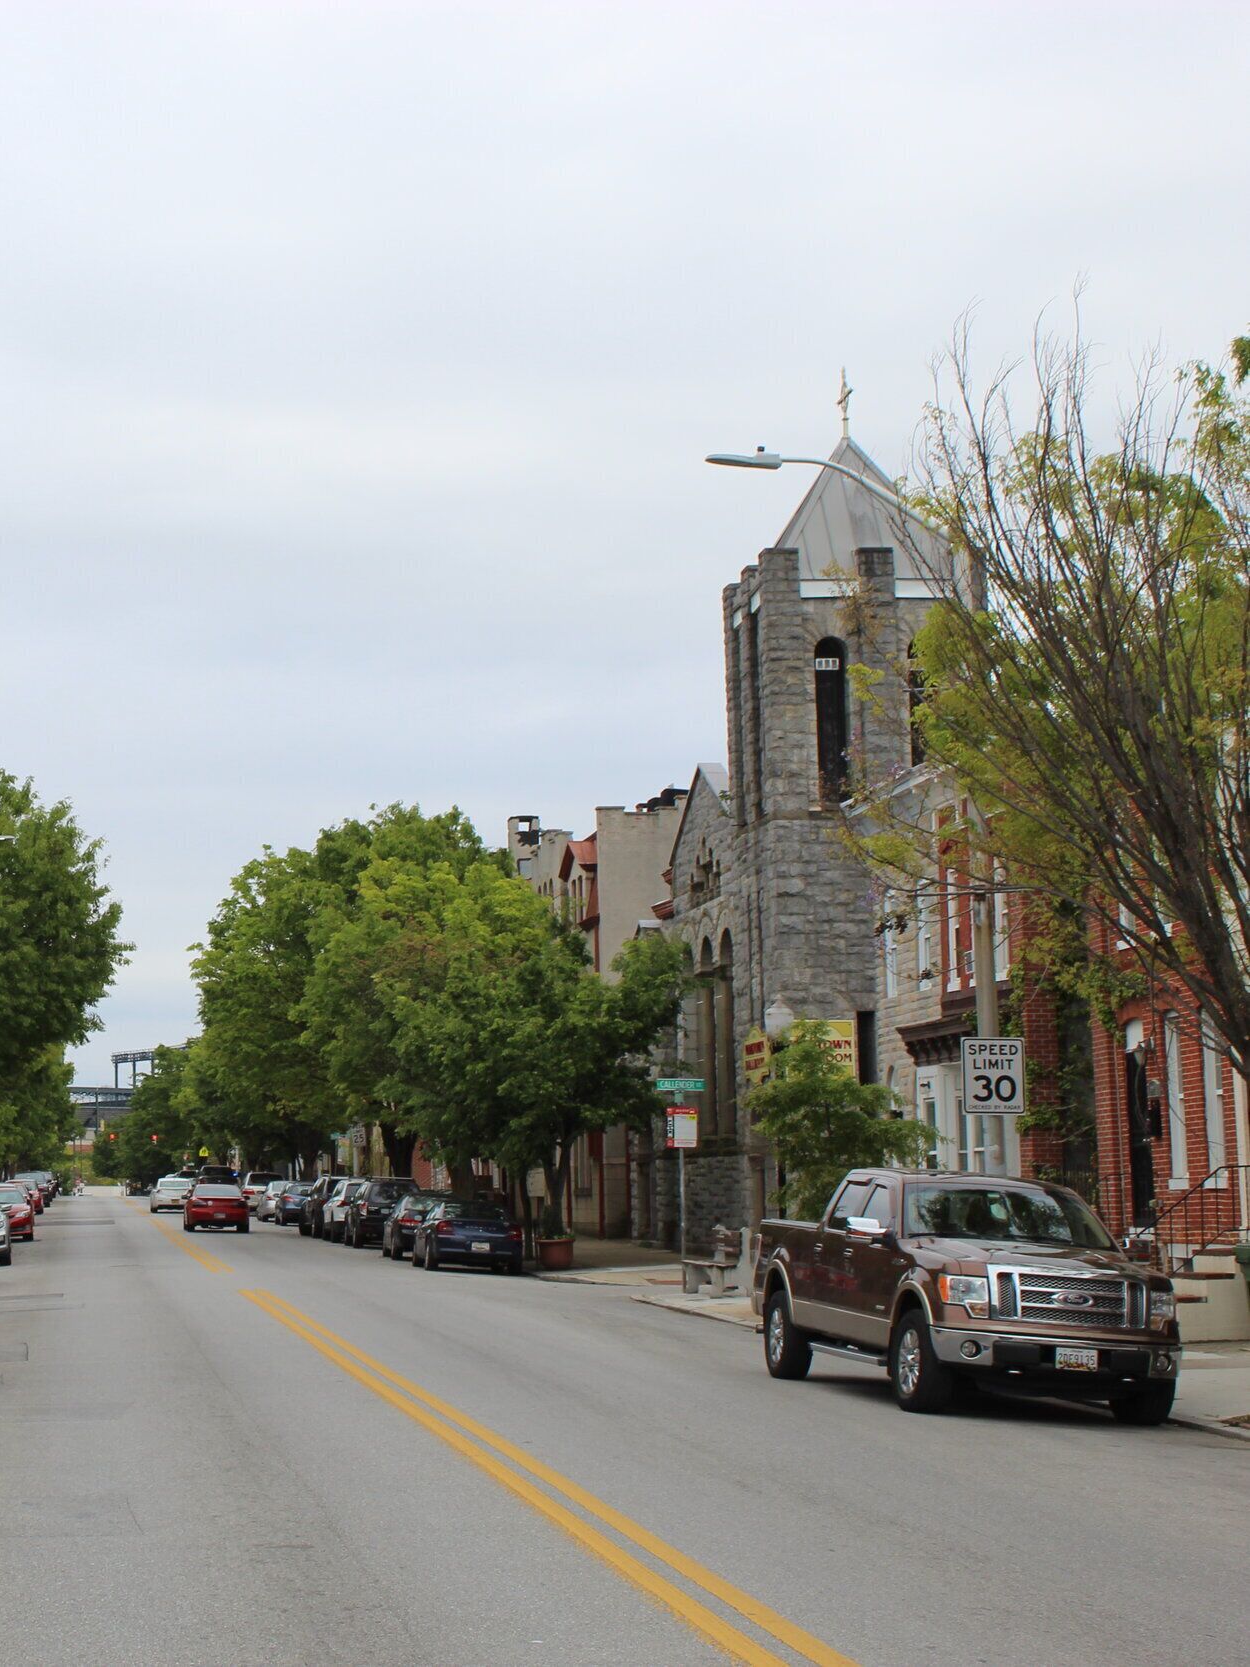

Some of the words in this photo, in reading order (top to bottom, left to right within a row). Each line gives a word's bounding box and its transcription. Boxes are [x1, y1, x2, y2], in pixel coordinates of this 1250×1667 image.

[968, 1044, 1018, 1056] SPEED
[973, 1058, 1014, 1070] LIMIT
[660, 1080, 695, 1089] CALLENDER
[972, 1074, 1017, 1103] 30
[353, 1134, 366, 1144] 25
